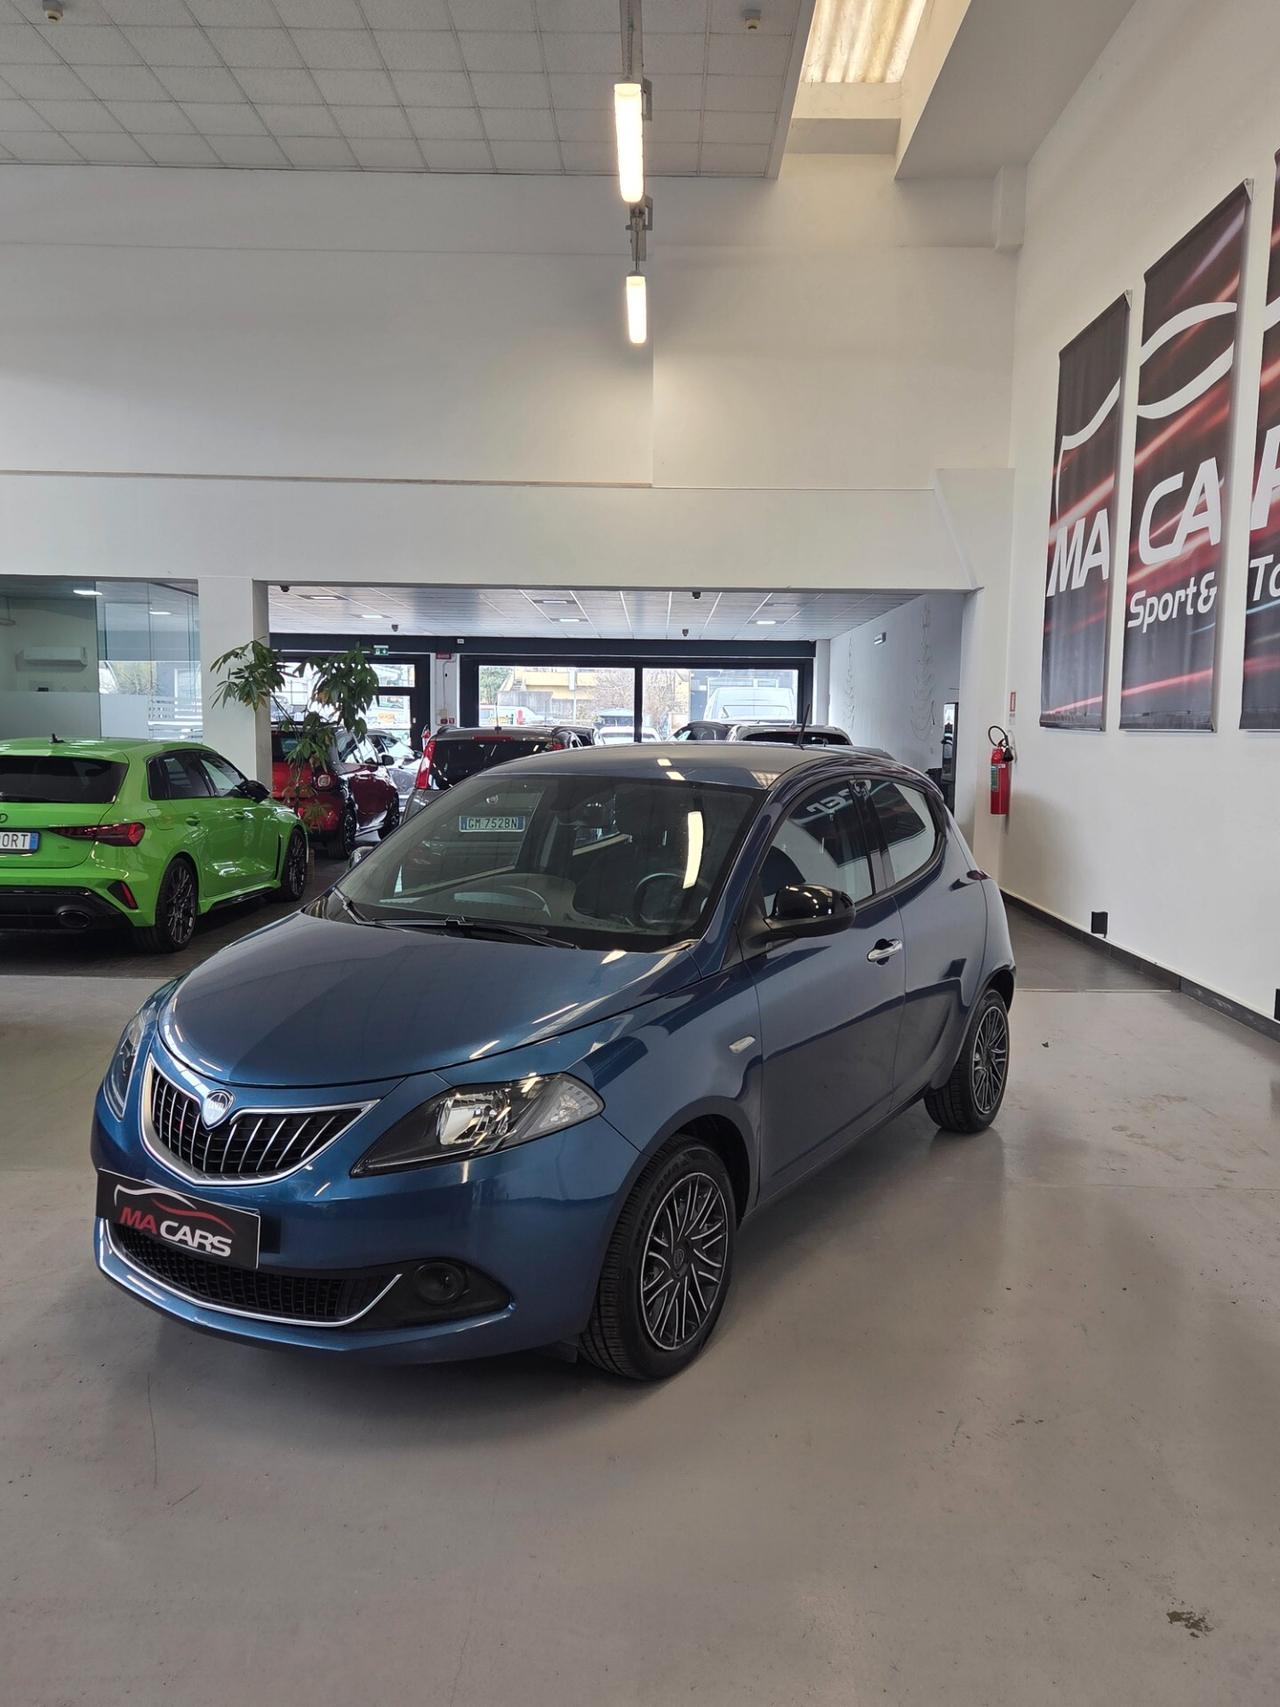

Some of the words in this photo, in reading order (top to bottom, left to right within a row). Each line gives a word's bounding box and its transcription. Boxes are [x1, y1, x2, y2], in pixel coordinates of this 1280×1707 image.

[1046, 508, 1110, 598] MA
[119, 1206, 158, 1235] MA
[159, 1220, 233, 1258] CARS
